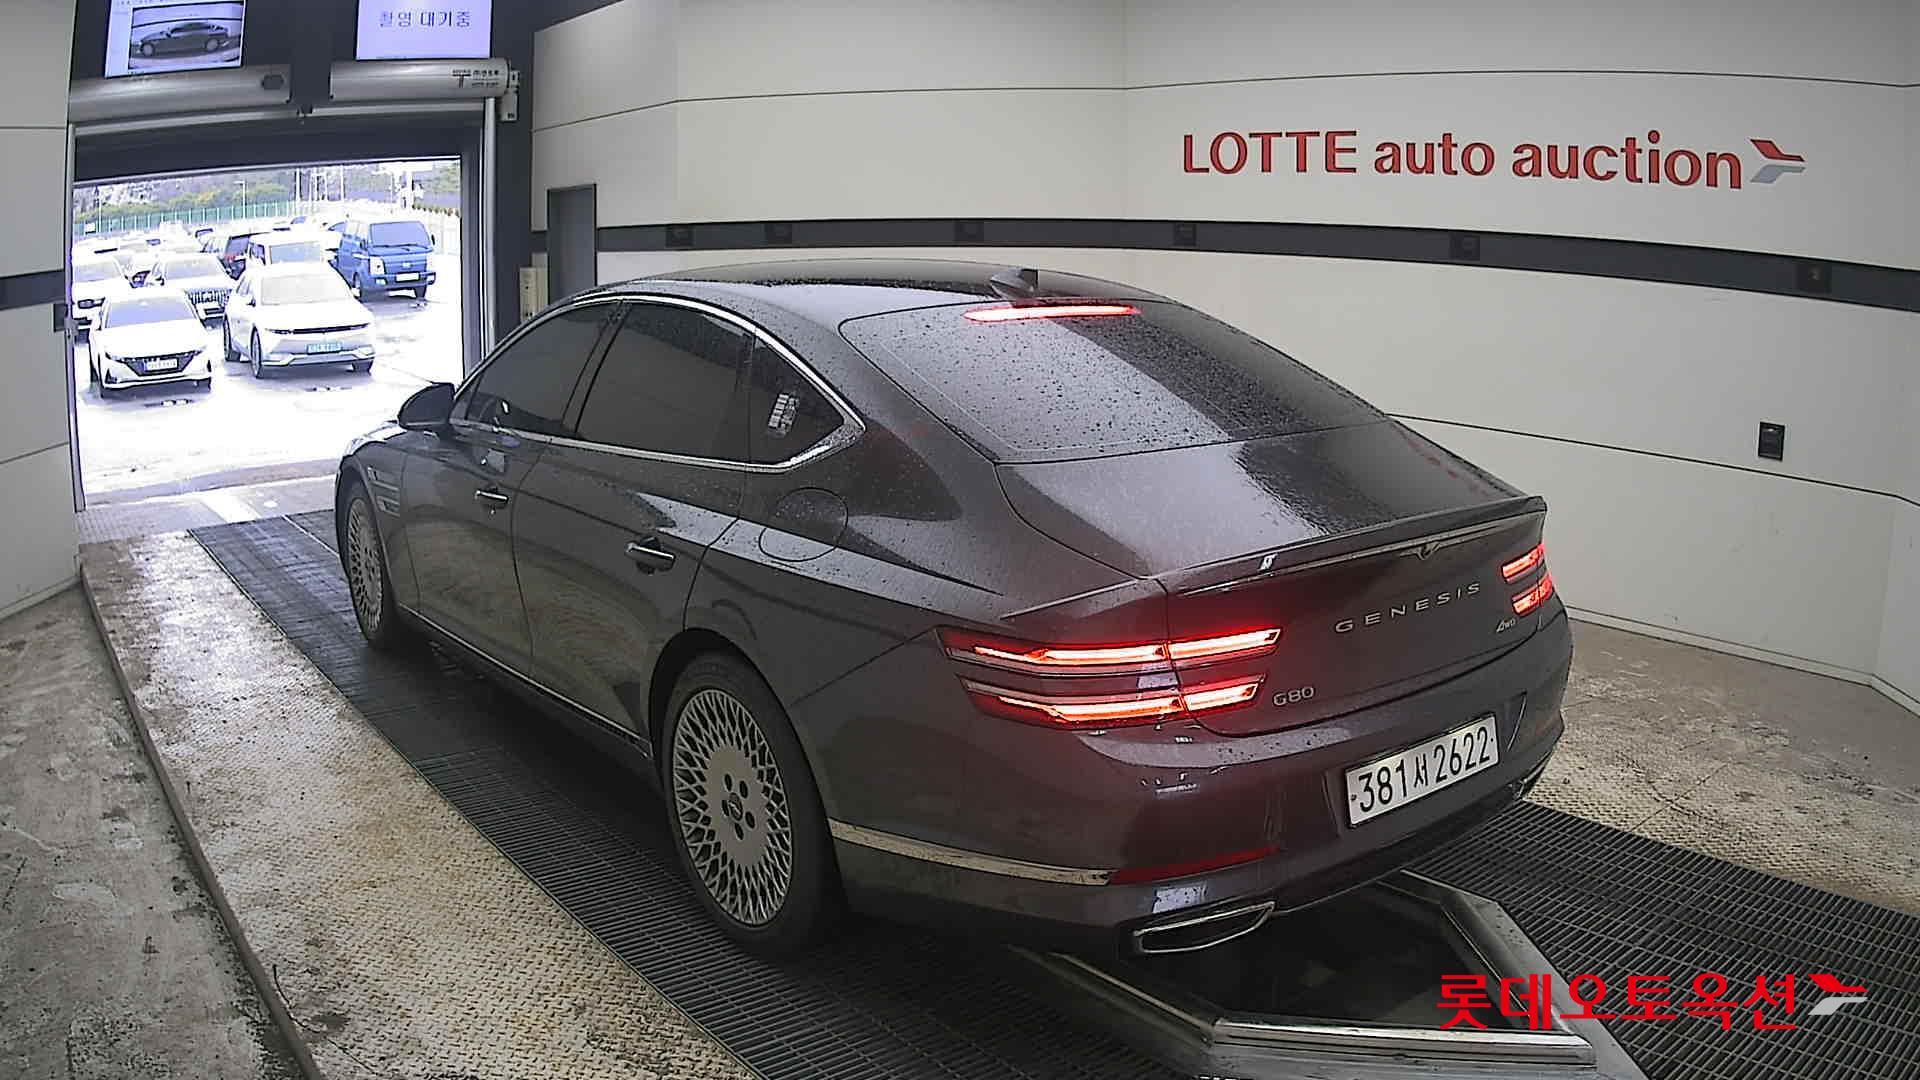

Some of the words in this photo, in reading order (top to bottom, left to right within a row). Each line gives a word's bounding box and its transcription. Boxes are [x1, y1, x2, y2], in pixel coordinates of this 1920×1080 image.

[420, 10, 470, 27] 대기중
[1183, 130, 1357, 174] LOTTE
[1374, 132, 1495, 176] auto
[1511, 129, 1742, 190] auction
[1335, 583, 1480, 633] GENESIS
[1273, 687, 1315, 706] G80
